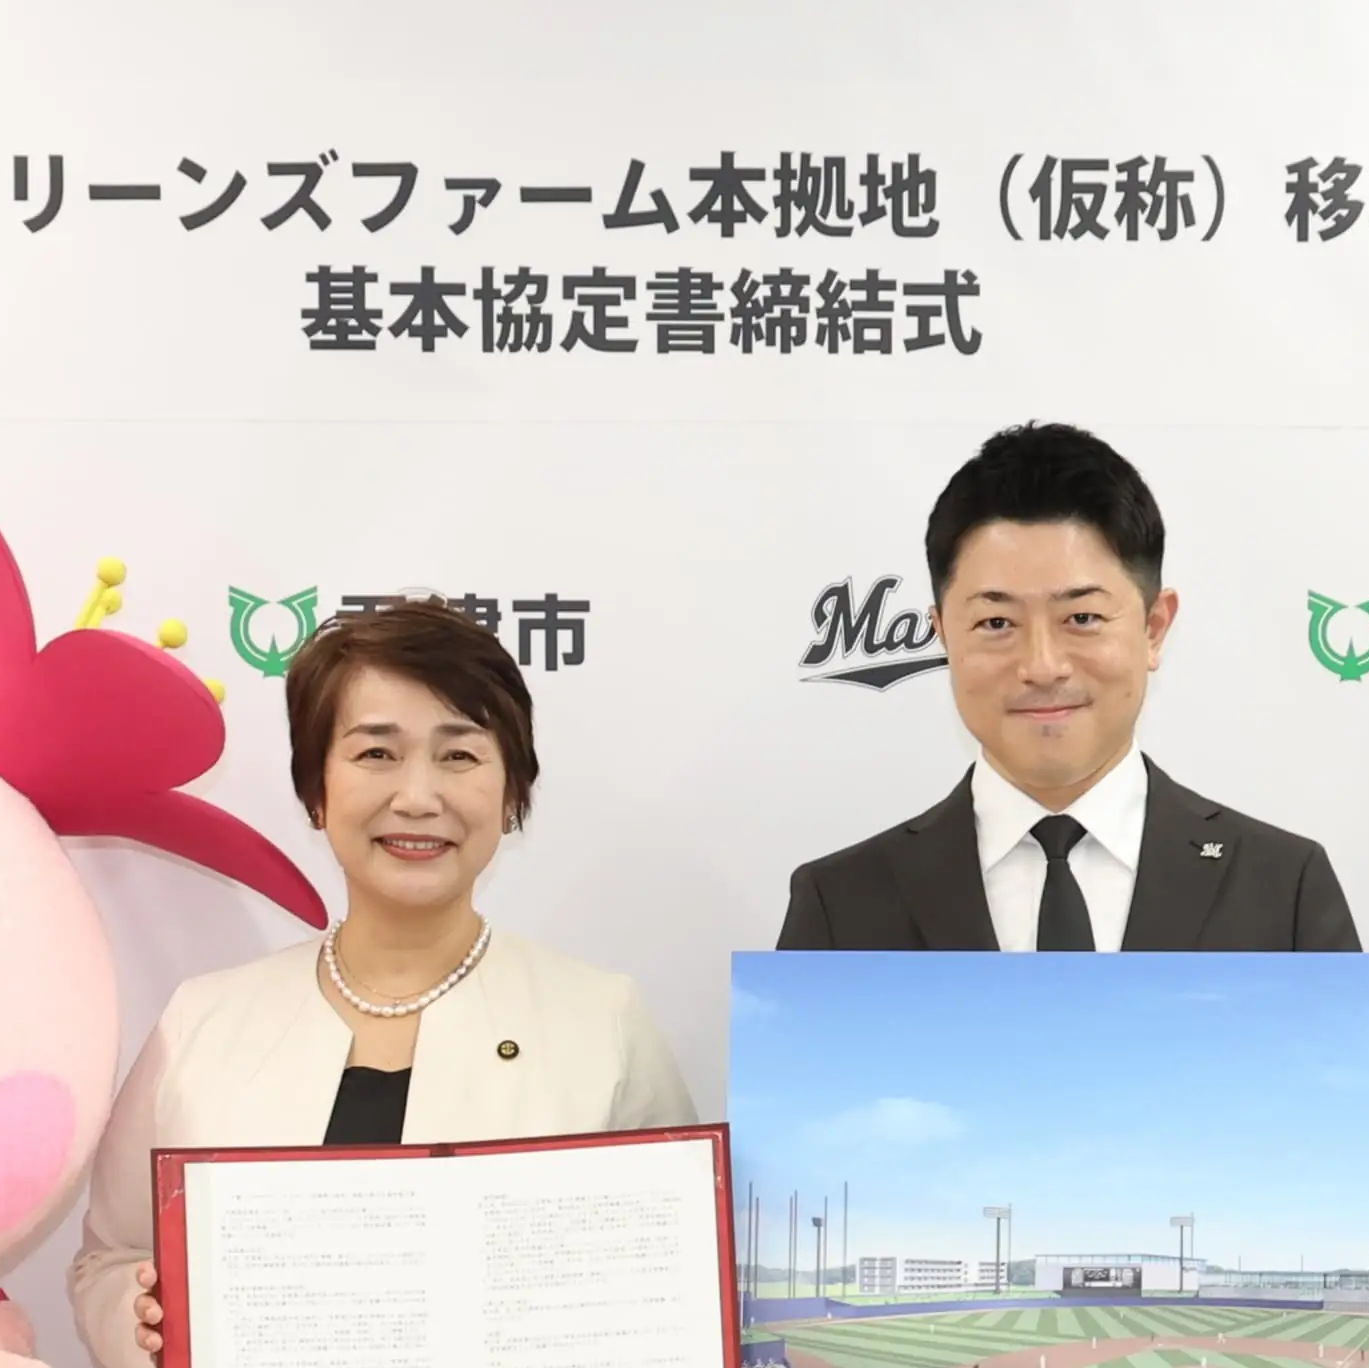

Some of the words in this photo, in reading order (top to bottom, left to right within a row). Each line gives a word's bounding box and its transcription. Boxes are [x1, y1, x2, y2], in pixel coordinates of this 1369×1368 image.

[300, 265, 983, 356] 基本協定書締結式
